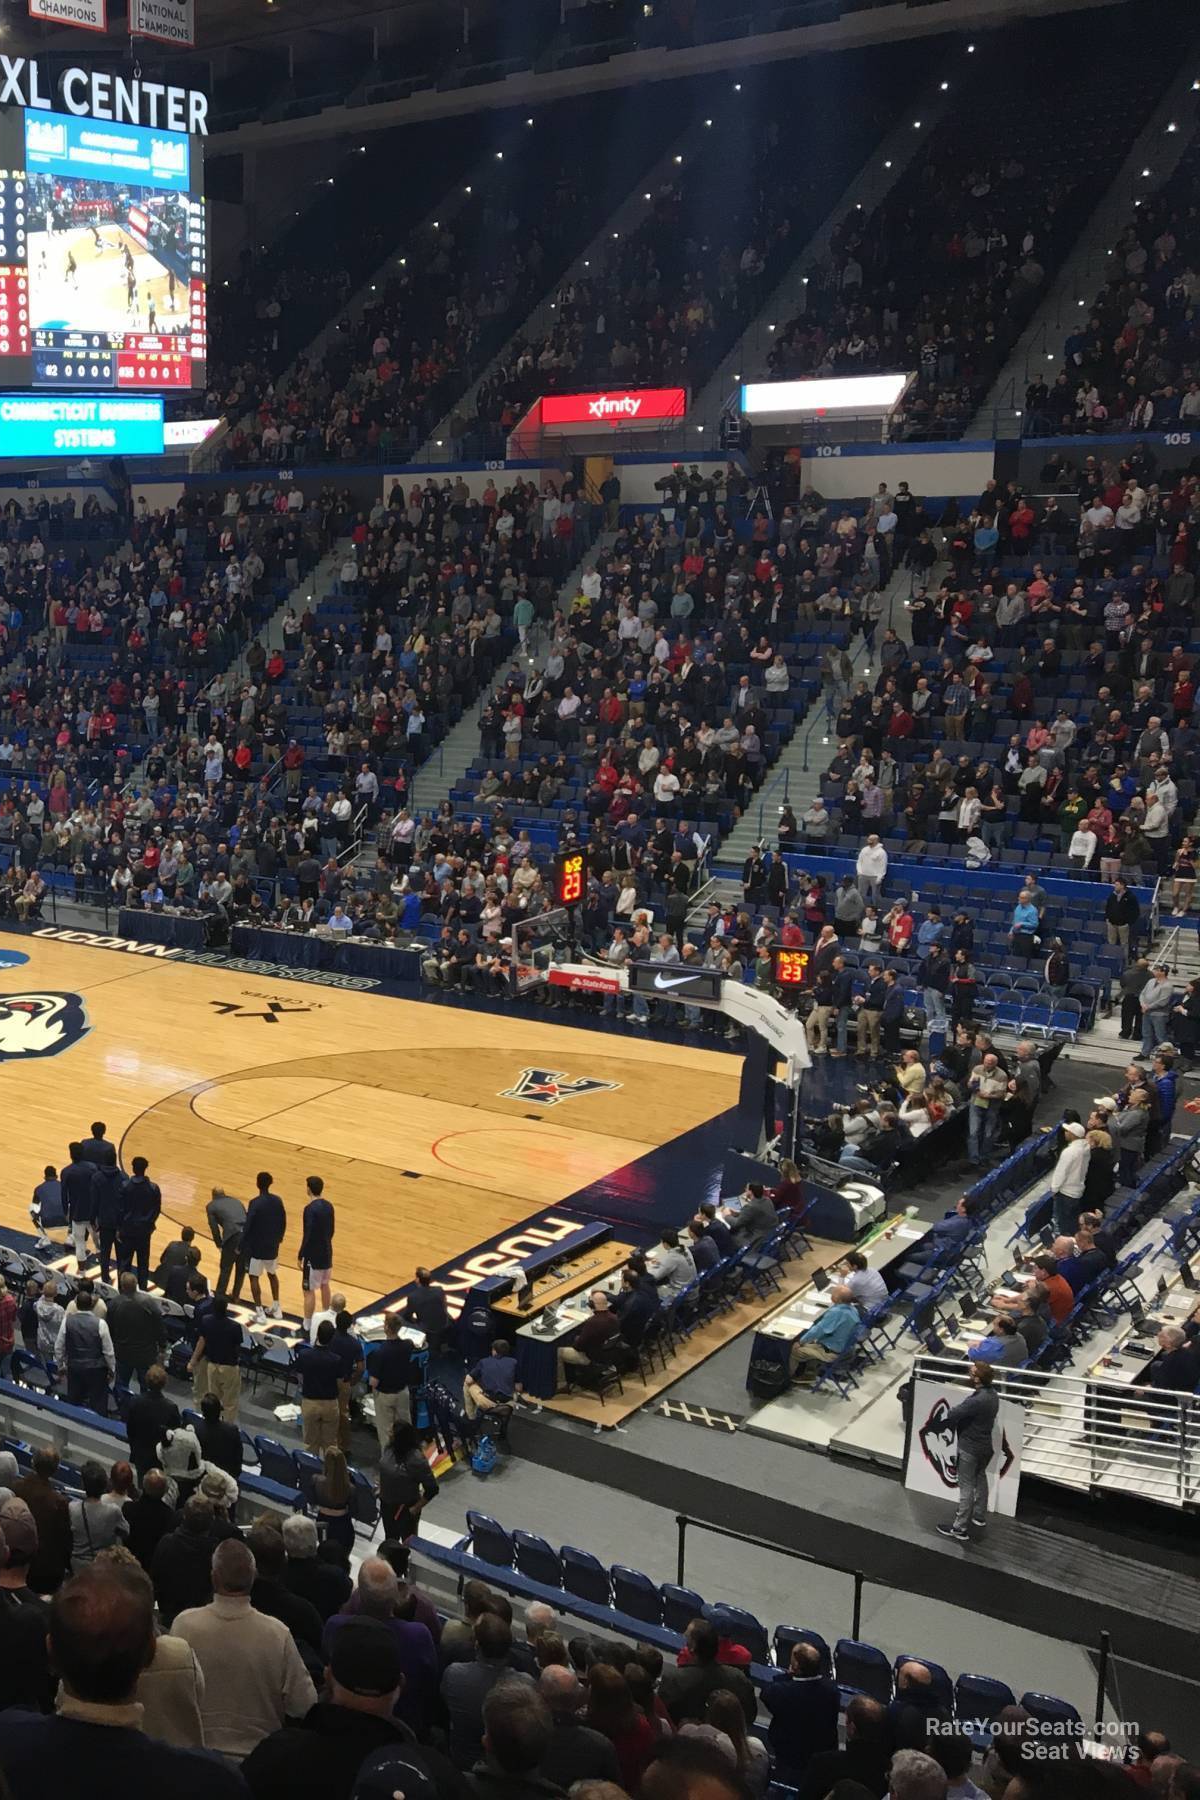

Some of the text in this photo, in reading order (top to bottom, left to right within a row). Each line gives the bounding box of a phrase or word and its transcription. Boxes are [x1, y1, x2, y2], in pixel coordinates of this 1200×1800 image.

[39, 0, 97, 23] CHAMPIONS
[141, 2, 186, 23] NATIONAL
[137, 17, 190, 40] CHAMPIONS
[0, 54, 209, 136] XL CENTER
[588, 396, 642, 418] xfinity
[1164, 433, 1191, 446] 105
[816, 446, 841, 457] 104
[485, 460, 505, 471] 103
[27, 479, 40, 489] 101
[278, 470, 294, 481] 102
[563, 872, 583, 901] 23
[31, 927, 383, 990] UCONN HUSKIES
[779, 952, 809, 965] 16:52
[782, 964, 802, 982] 23
